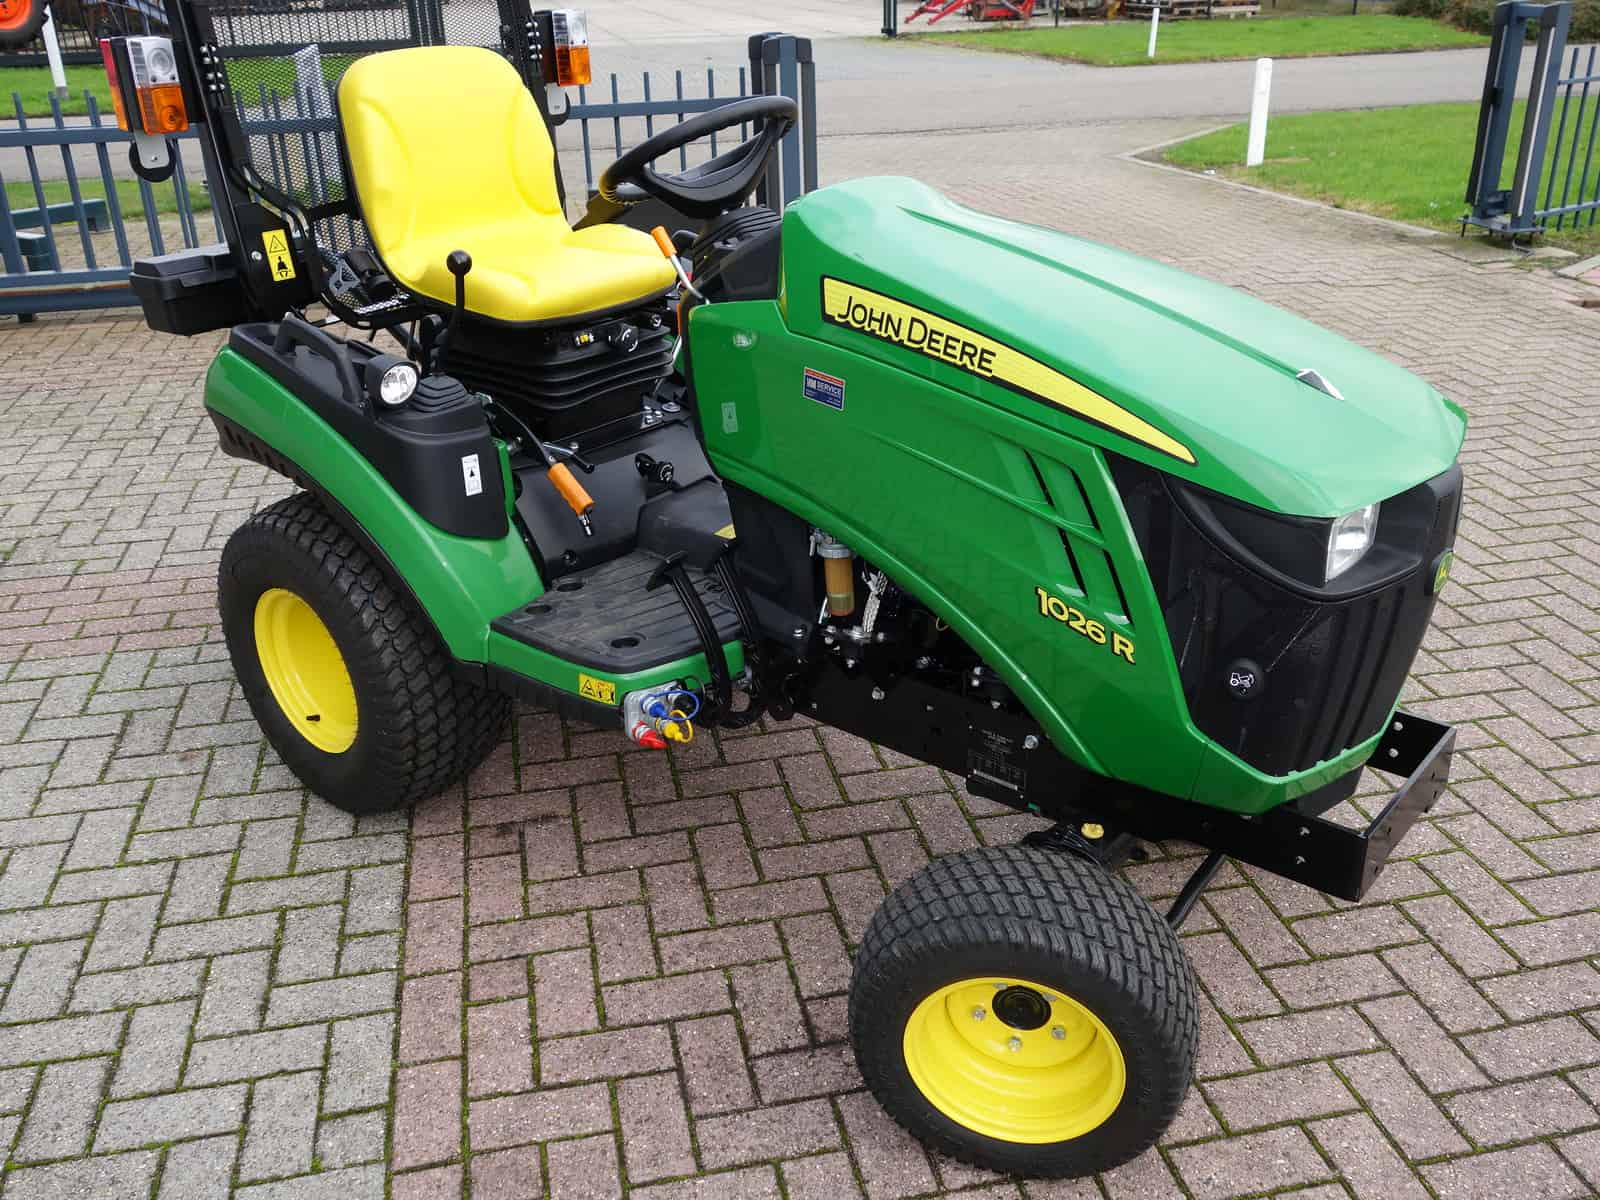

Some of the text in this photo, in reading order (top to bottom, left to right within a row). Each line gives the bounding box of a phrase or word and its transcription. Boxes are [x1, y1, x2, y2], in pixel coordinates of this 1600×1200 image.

[837, 295, 997, 374] JOHN DEERE
[816, 380, 842, 396] SERVICE
